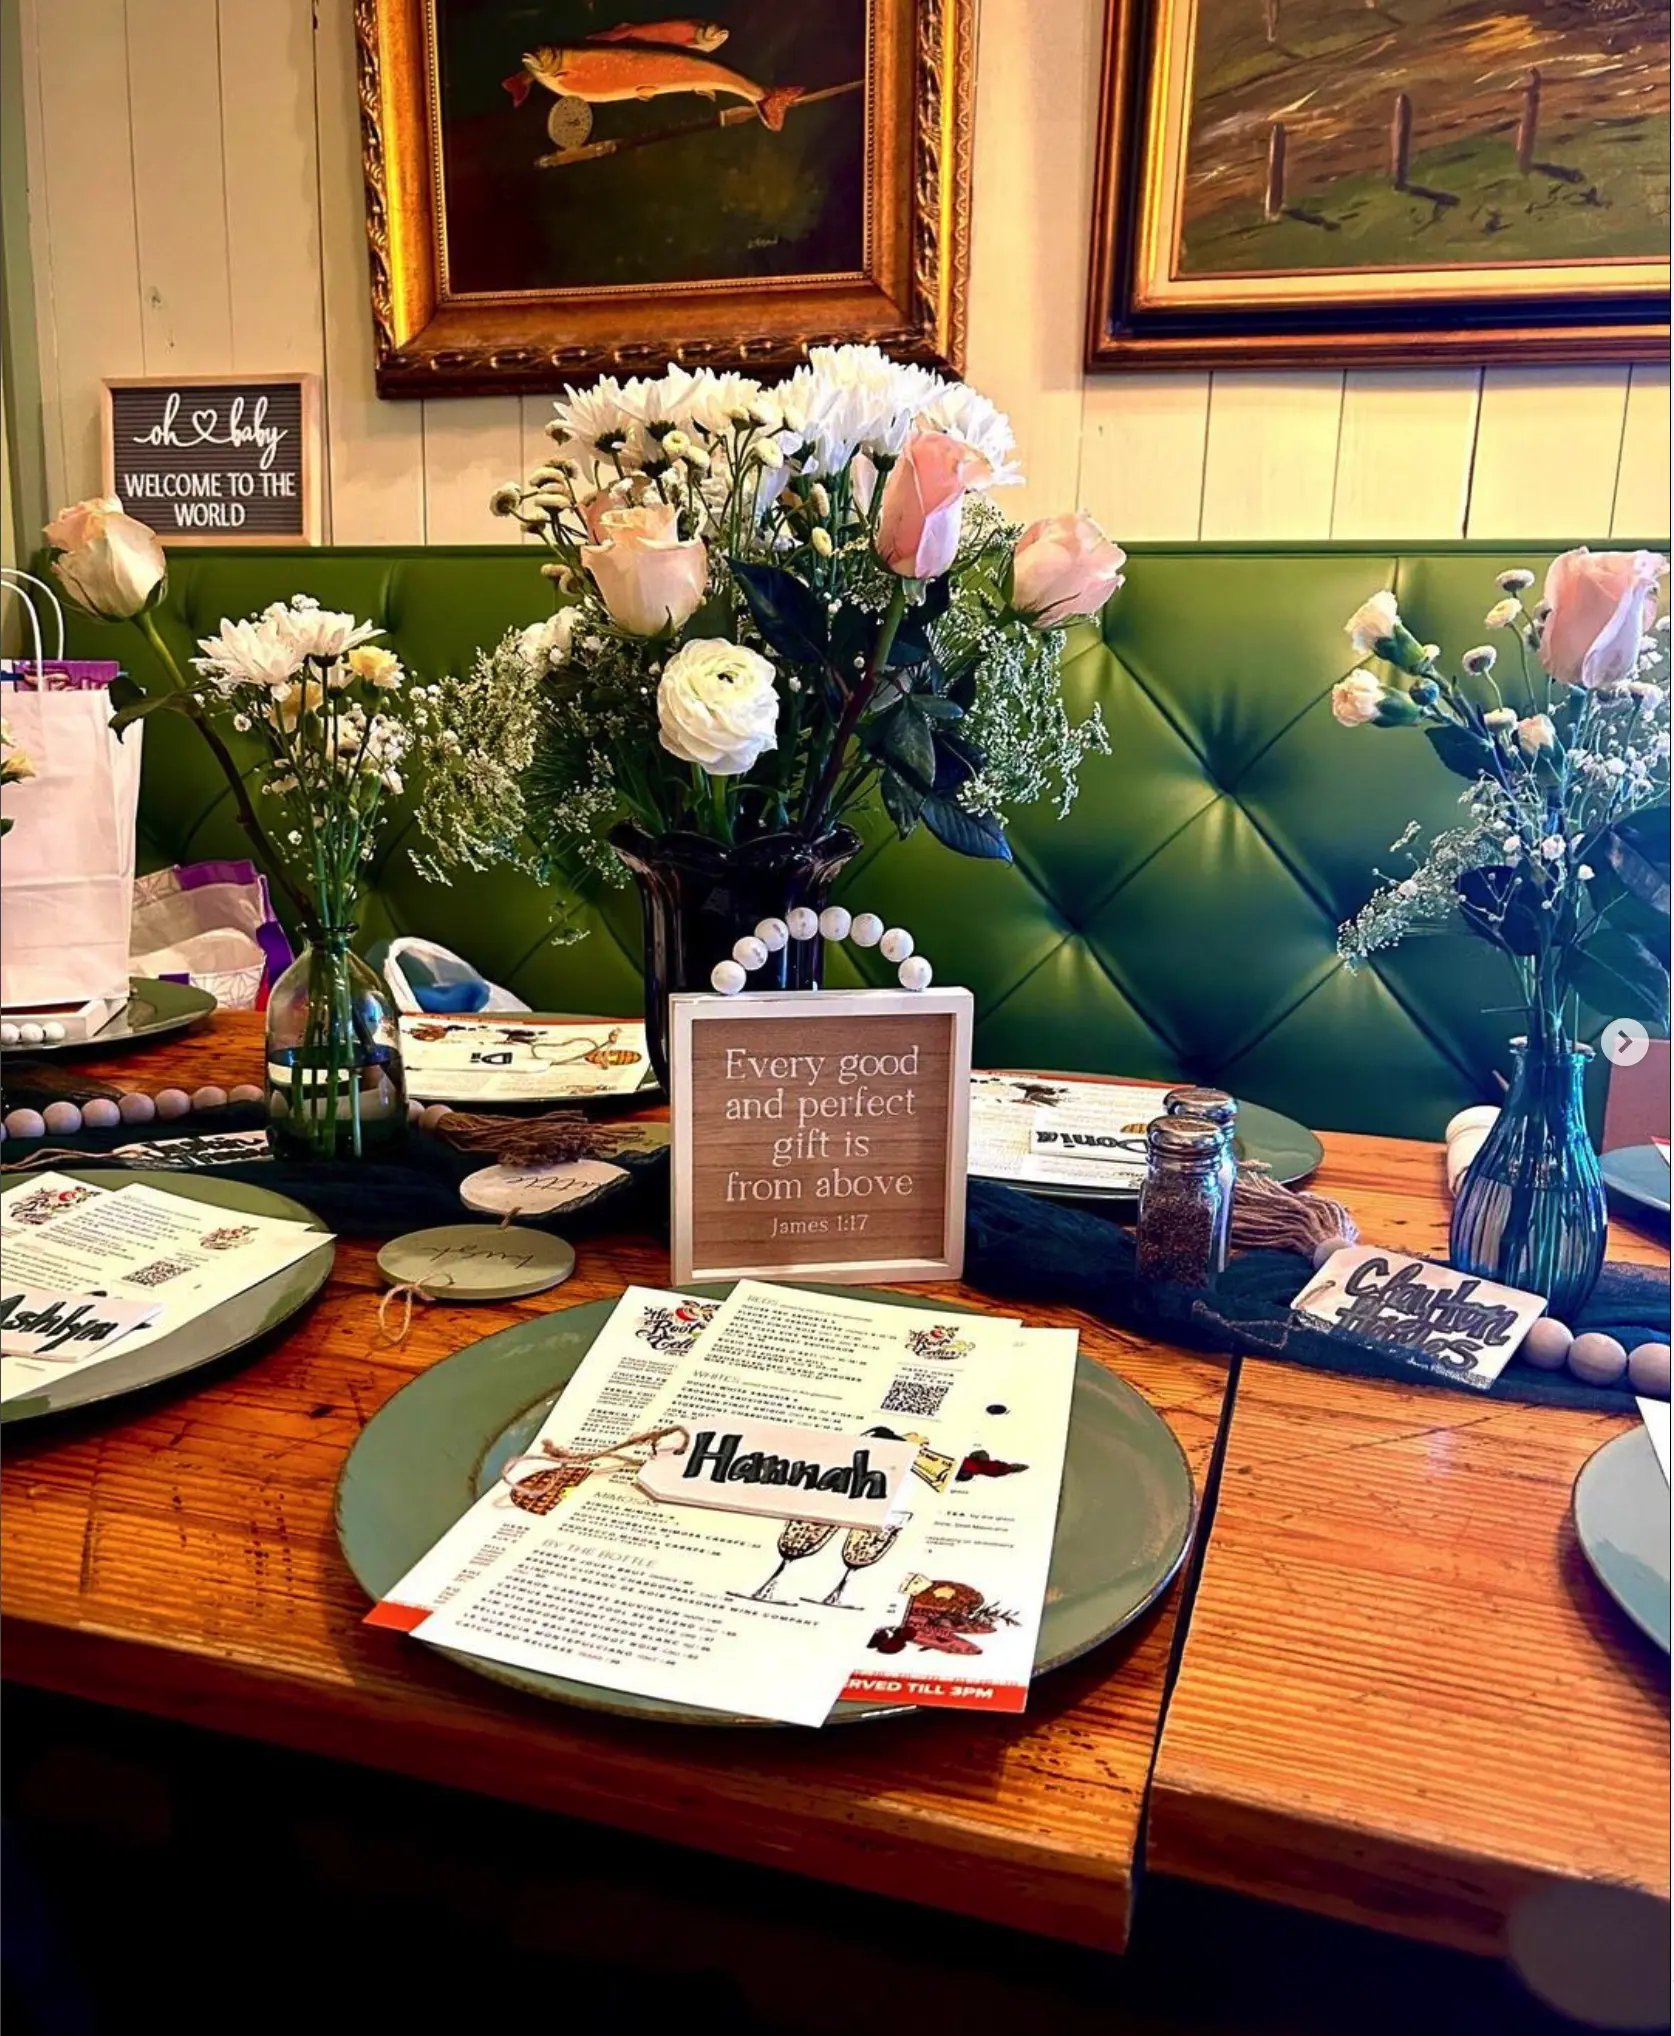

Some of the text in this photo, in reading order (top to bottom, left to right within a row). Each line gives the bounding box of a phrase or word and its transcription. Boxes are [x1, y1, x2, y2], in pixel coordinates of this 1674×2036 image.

[133, 393, 288, 470] oh baby
[124, 472, 296, 497] WELCOME TO THE
[174, 503, 245, 527] WORLD
[470, 1050, 513, 1066] Di
[725, 1045, 919, 1086] Every good
[726, 1086, 916, 1128] and perfect
[772, 1128, 870, 1167] gift is
[725, 1168, 913, 1202] from above
[770, 1214, 869, 1238] James 1:17
[1345, 1257, 1519, 1346] Clayton
[683, 1431, 887, 1499] Hannah
[849, 1678, 995, 1700] RVED TILL 3PM
